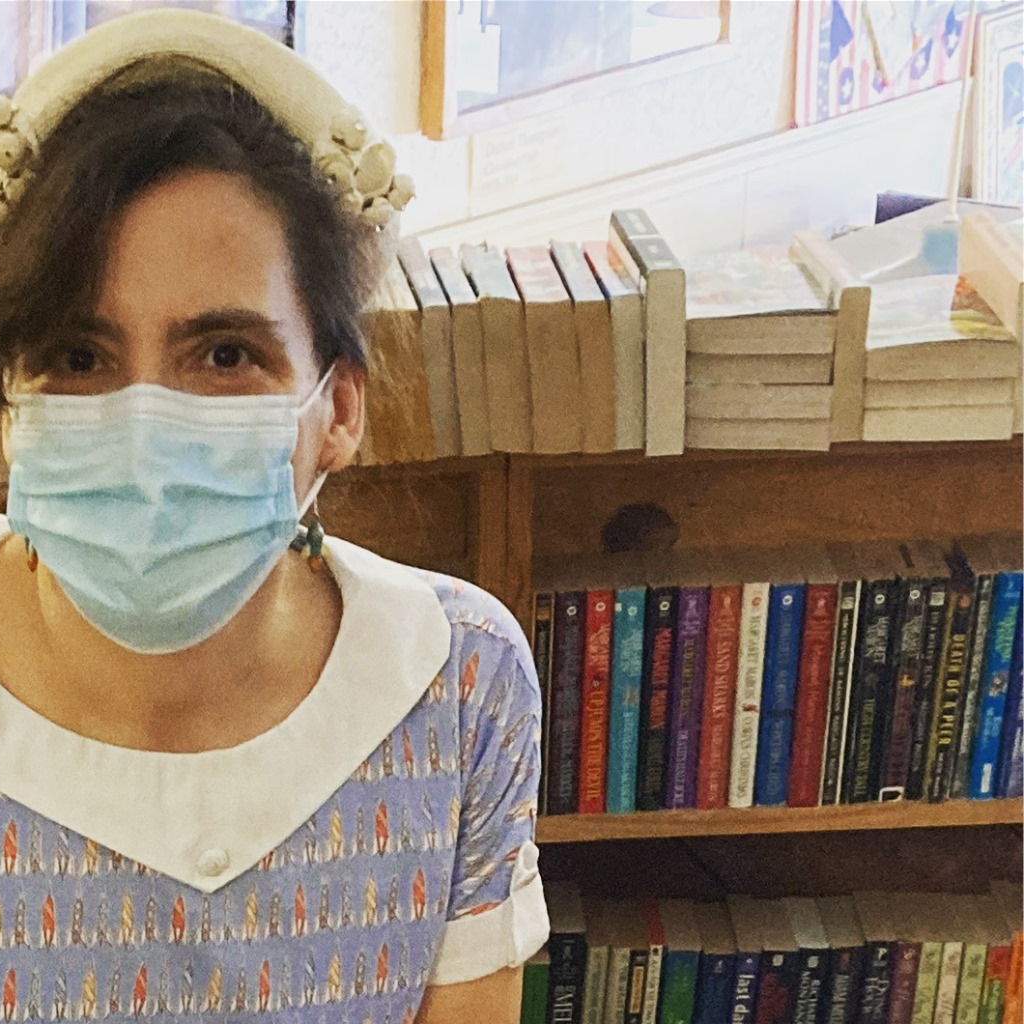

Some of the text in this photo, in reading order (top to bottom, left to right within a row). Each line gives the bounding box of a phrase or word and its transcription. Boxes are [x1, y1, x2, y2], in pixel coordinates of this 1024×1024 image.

[715, 641, 729, 672] SAND
[947, 633, 965, 673] DEATH
[712, 674, 727, 718] SHARKS
[945, 679, 959, 693] OF
[938, 714, 953, 745] PEER
[586, 768, 601, 799] DEVIL
[735, 973, 754, 1001] last
